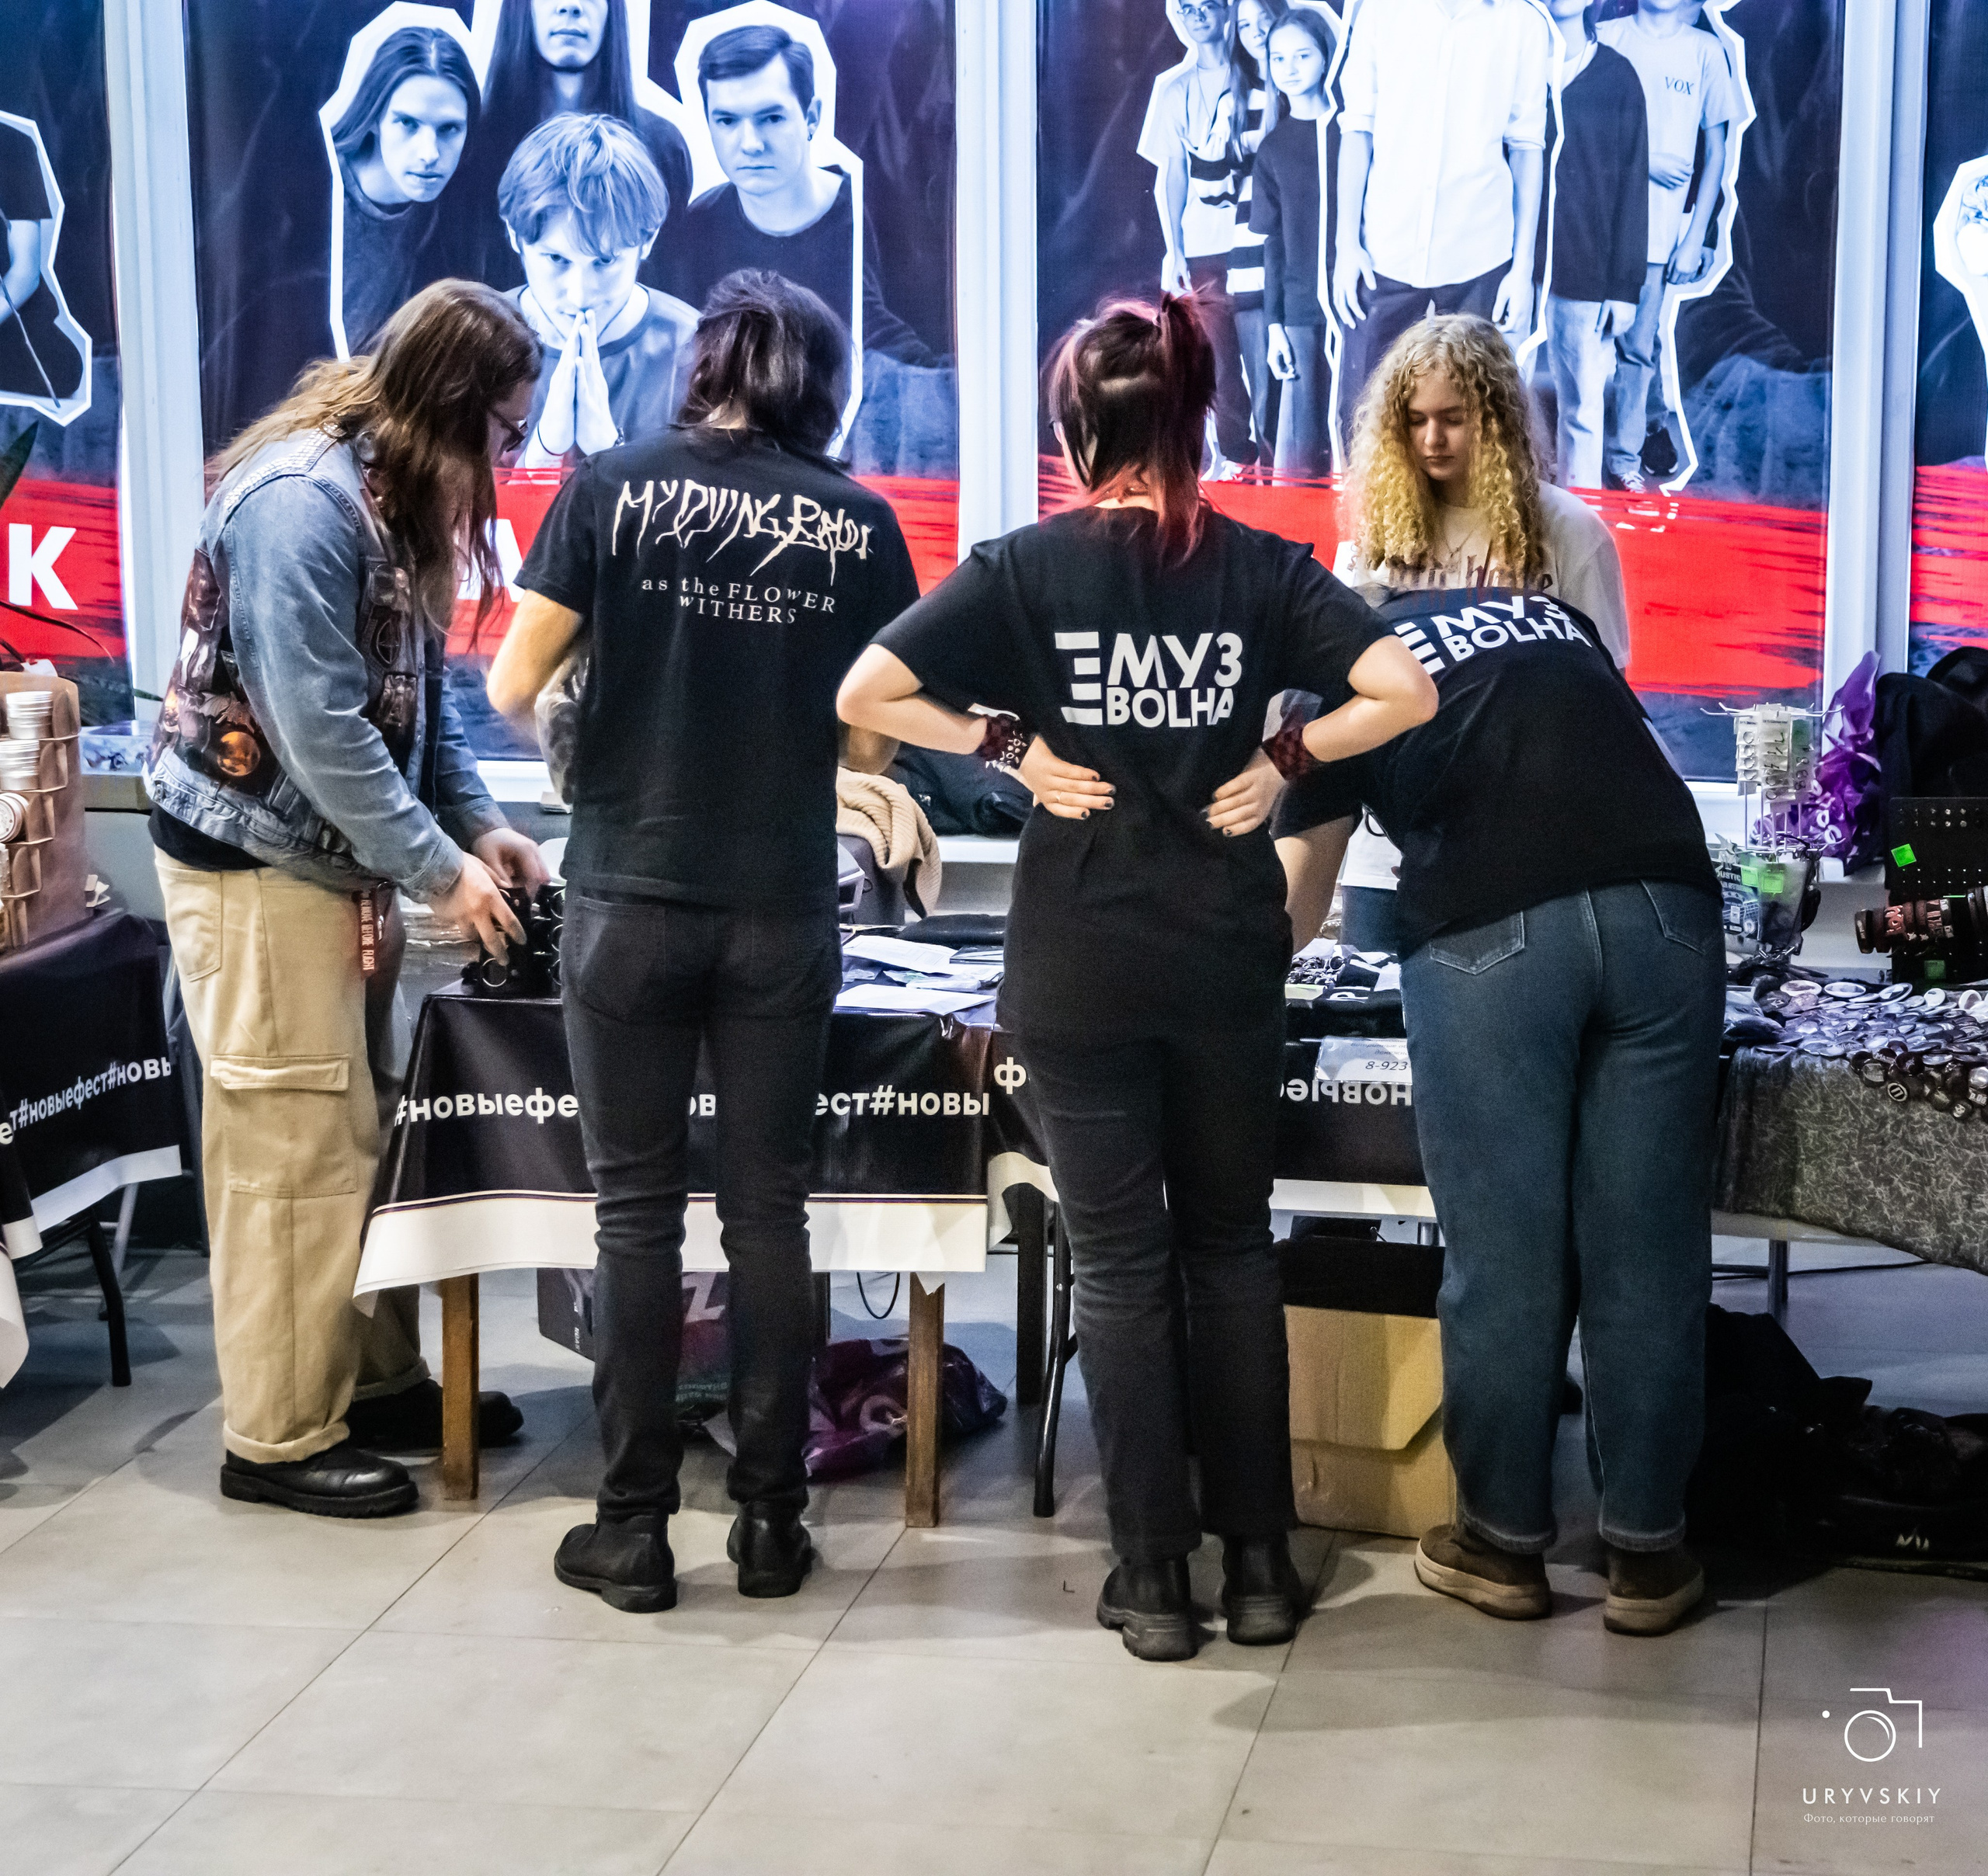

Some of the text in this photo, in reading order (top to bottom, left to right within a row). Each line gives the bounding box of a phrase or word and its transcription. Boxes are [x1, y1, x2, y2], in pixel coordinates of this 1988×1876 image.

[1665, 76, 1694, 95] VOX
[641, 578, 668, 591] as
[680, 577, 719, 596] the
